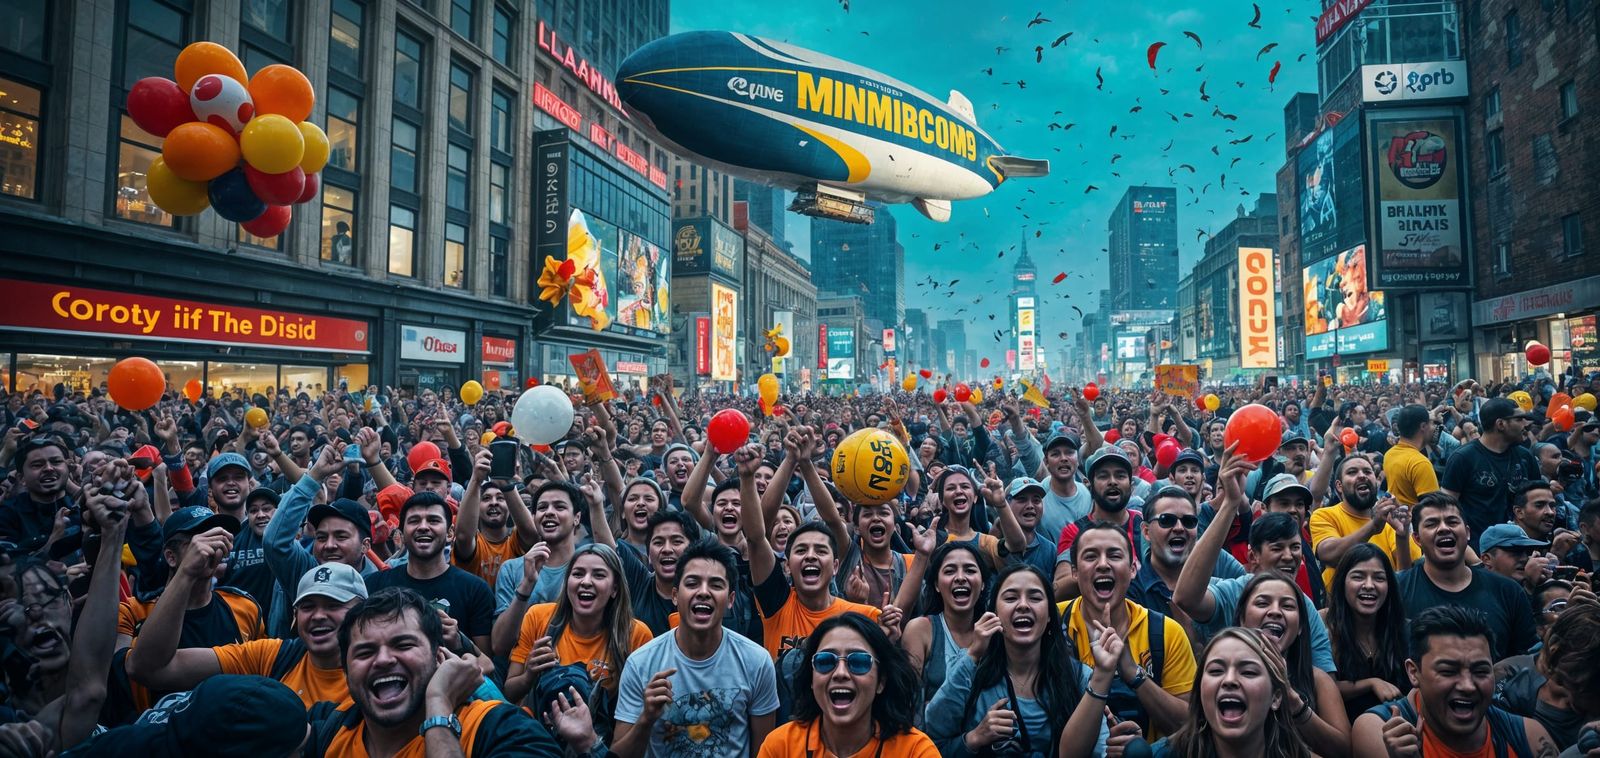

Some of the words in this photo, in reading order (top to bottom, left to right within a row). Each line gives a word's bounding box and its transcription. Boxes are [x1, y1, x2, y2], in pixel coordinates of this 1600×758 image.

[797, 71, 977, 162] MINMIBCOM9
[52, 291, 160, 334] Coroty
[208, 310, 253, 335] The
[260, 314, 316, 340] Disid
